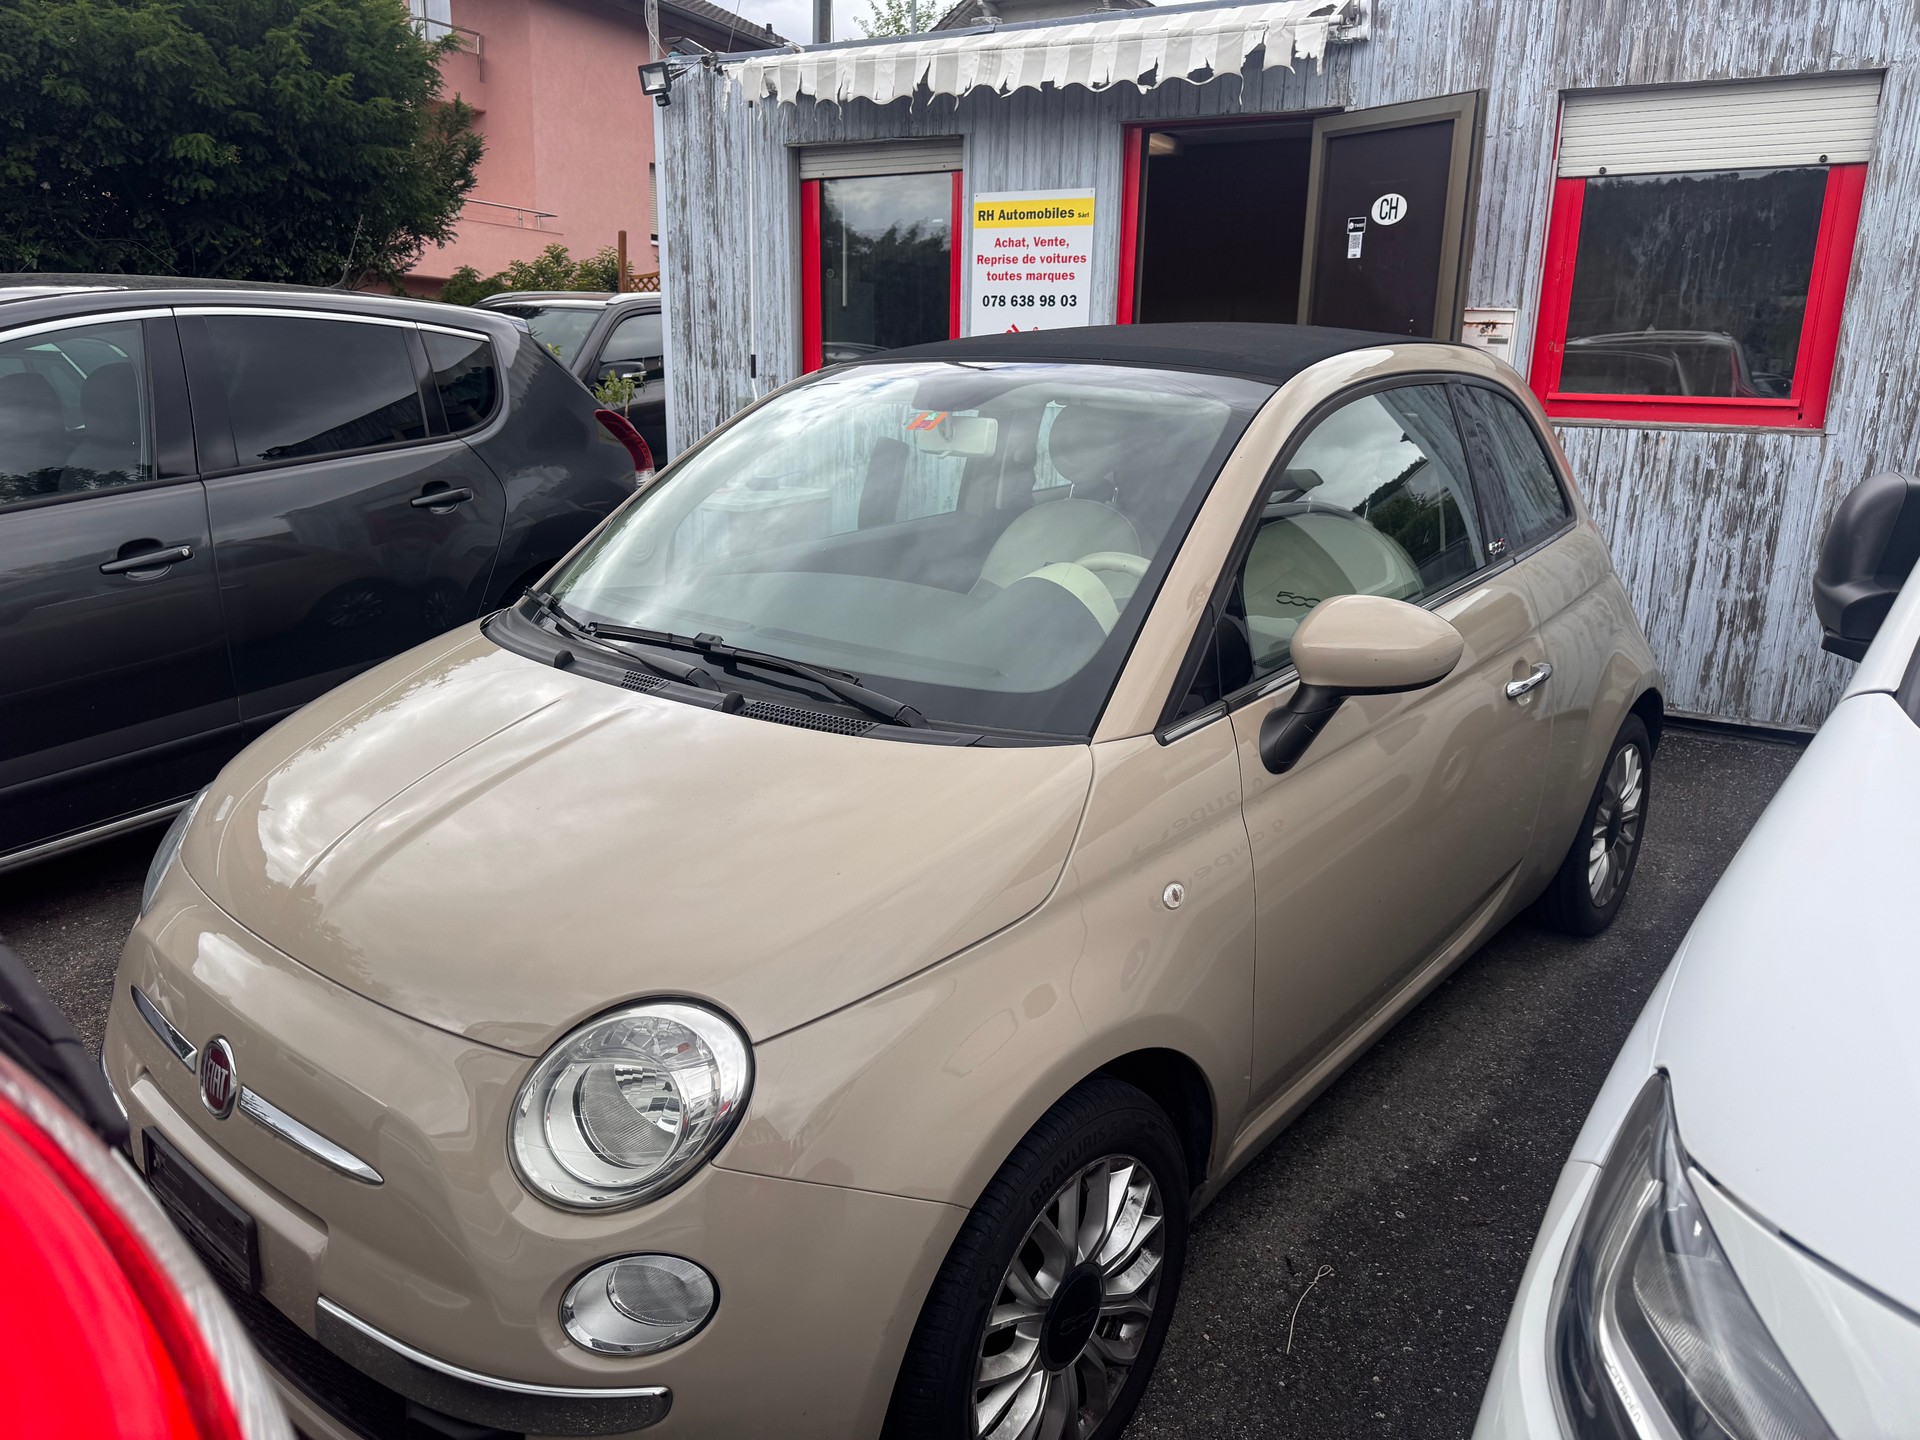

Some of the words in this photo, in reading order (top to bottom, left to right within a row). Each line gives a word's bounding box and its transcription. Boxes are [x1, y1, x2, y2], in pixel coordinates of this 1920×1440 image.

[978, 210, 995, 222] RH
[998, 207, 1075, 221] Automobiles
[1379, 197, 1400, 220] CH
[994, 237, 1030, 249] Achat,
[1033, 236, 1070, 248] Vente,
[976, 254, 1018, 267] Reprise
[1022, 254, 1036, 264] de
[1039, 253, 1087, 264] voitures
[986, 271, 1022, 281] toutes
[1026, 271, 1075, 283] marques
[982, 294, 1006, 307] 078
[1010, 294, 1035, 307] 638
[1039, 294, 1056, 307] 98
[1060, 294, 1077, 307] 03
[205, 1057, 229, 1101] FIAT
